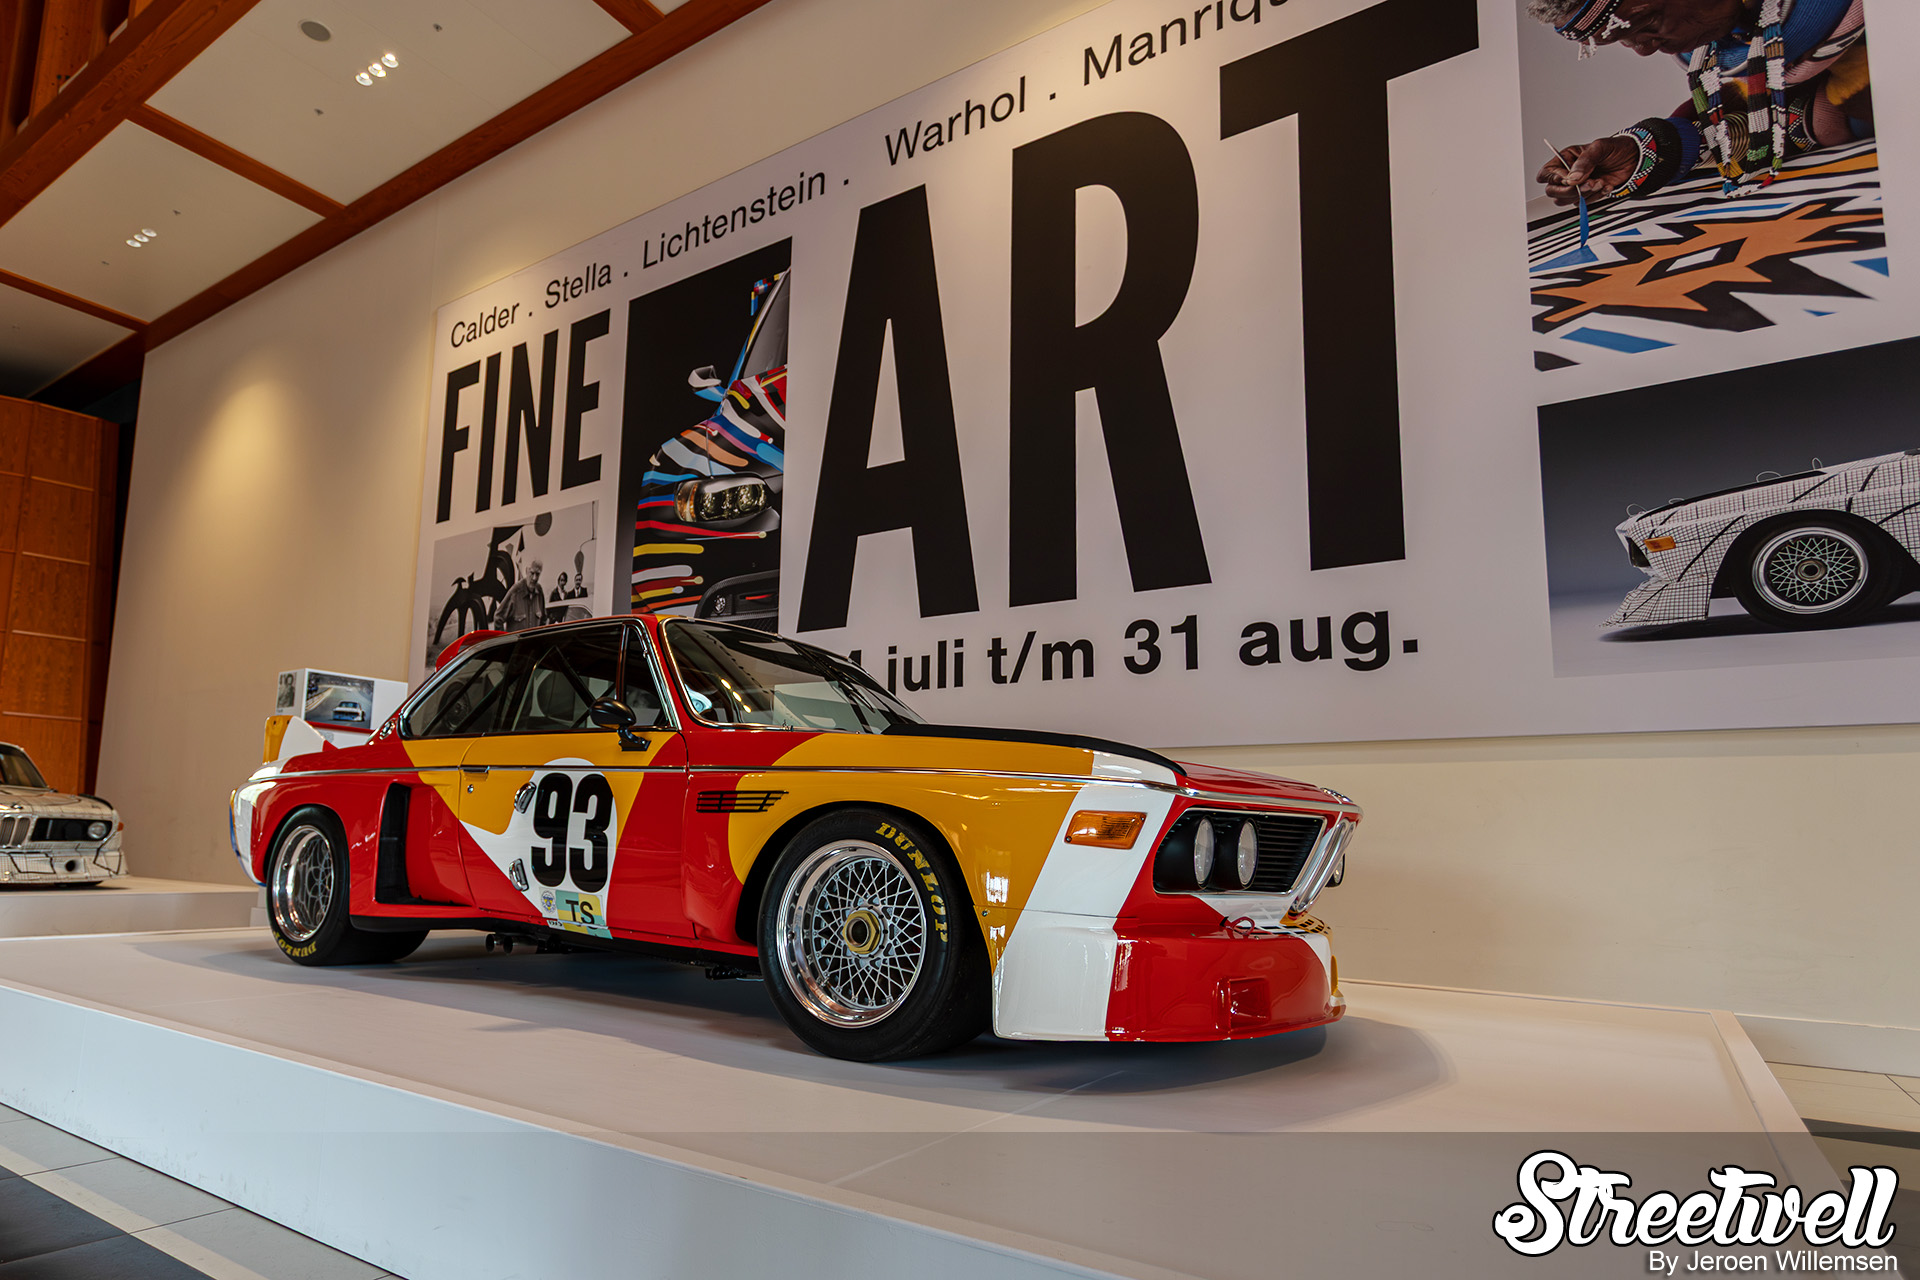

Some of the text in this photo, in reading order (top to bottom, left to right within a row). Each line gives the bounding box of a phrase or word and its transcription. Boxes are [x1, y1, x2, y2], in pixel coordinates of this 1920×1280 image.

[451, 303, 520, 348] Calder
[544, 264, 612, 309] Stella
[643, 171, 826, 269] Lichtenstein
[884, 75, 1026, 166] Warhol
[1083, 0, 1289, 86] Manriq
[436, 0, 1480, 633] FINE ART
[887, 610, 1419, 695] juli t/m 31 aug.
[531, 772, 614, 893] 93
[875, 822, 949, 943] DUNLOP
[565, 899, 596, 930] TS
